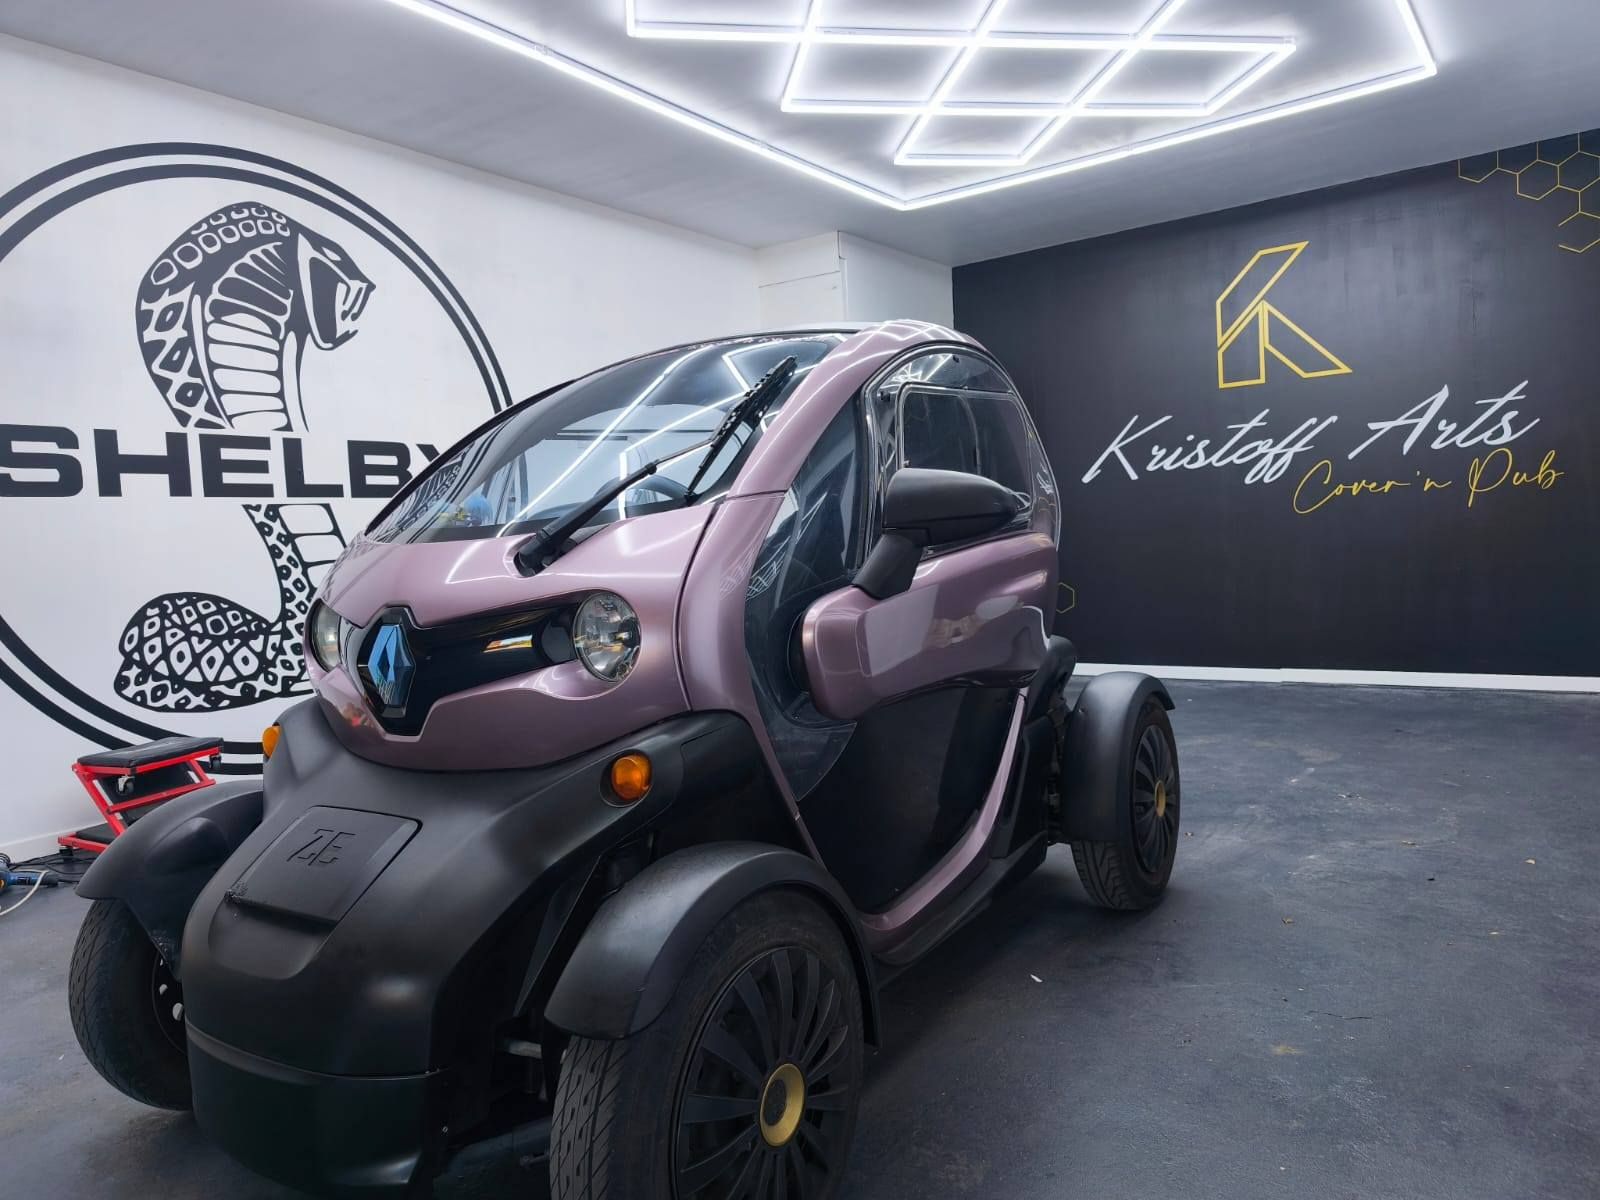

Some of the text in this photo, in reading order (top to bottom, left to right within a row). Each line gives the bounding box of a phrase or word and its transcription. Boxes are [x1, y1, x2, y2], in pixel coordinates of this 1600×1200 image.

[1083, 380, 1540, 484] Kristoff Arts
[1468, 447, 1565, 508] Pub
